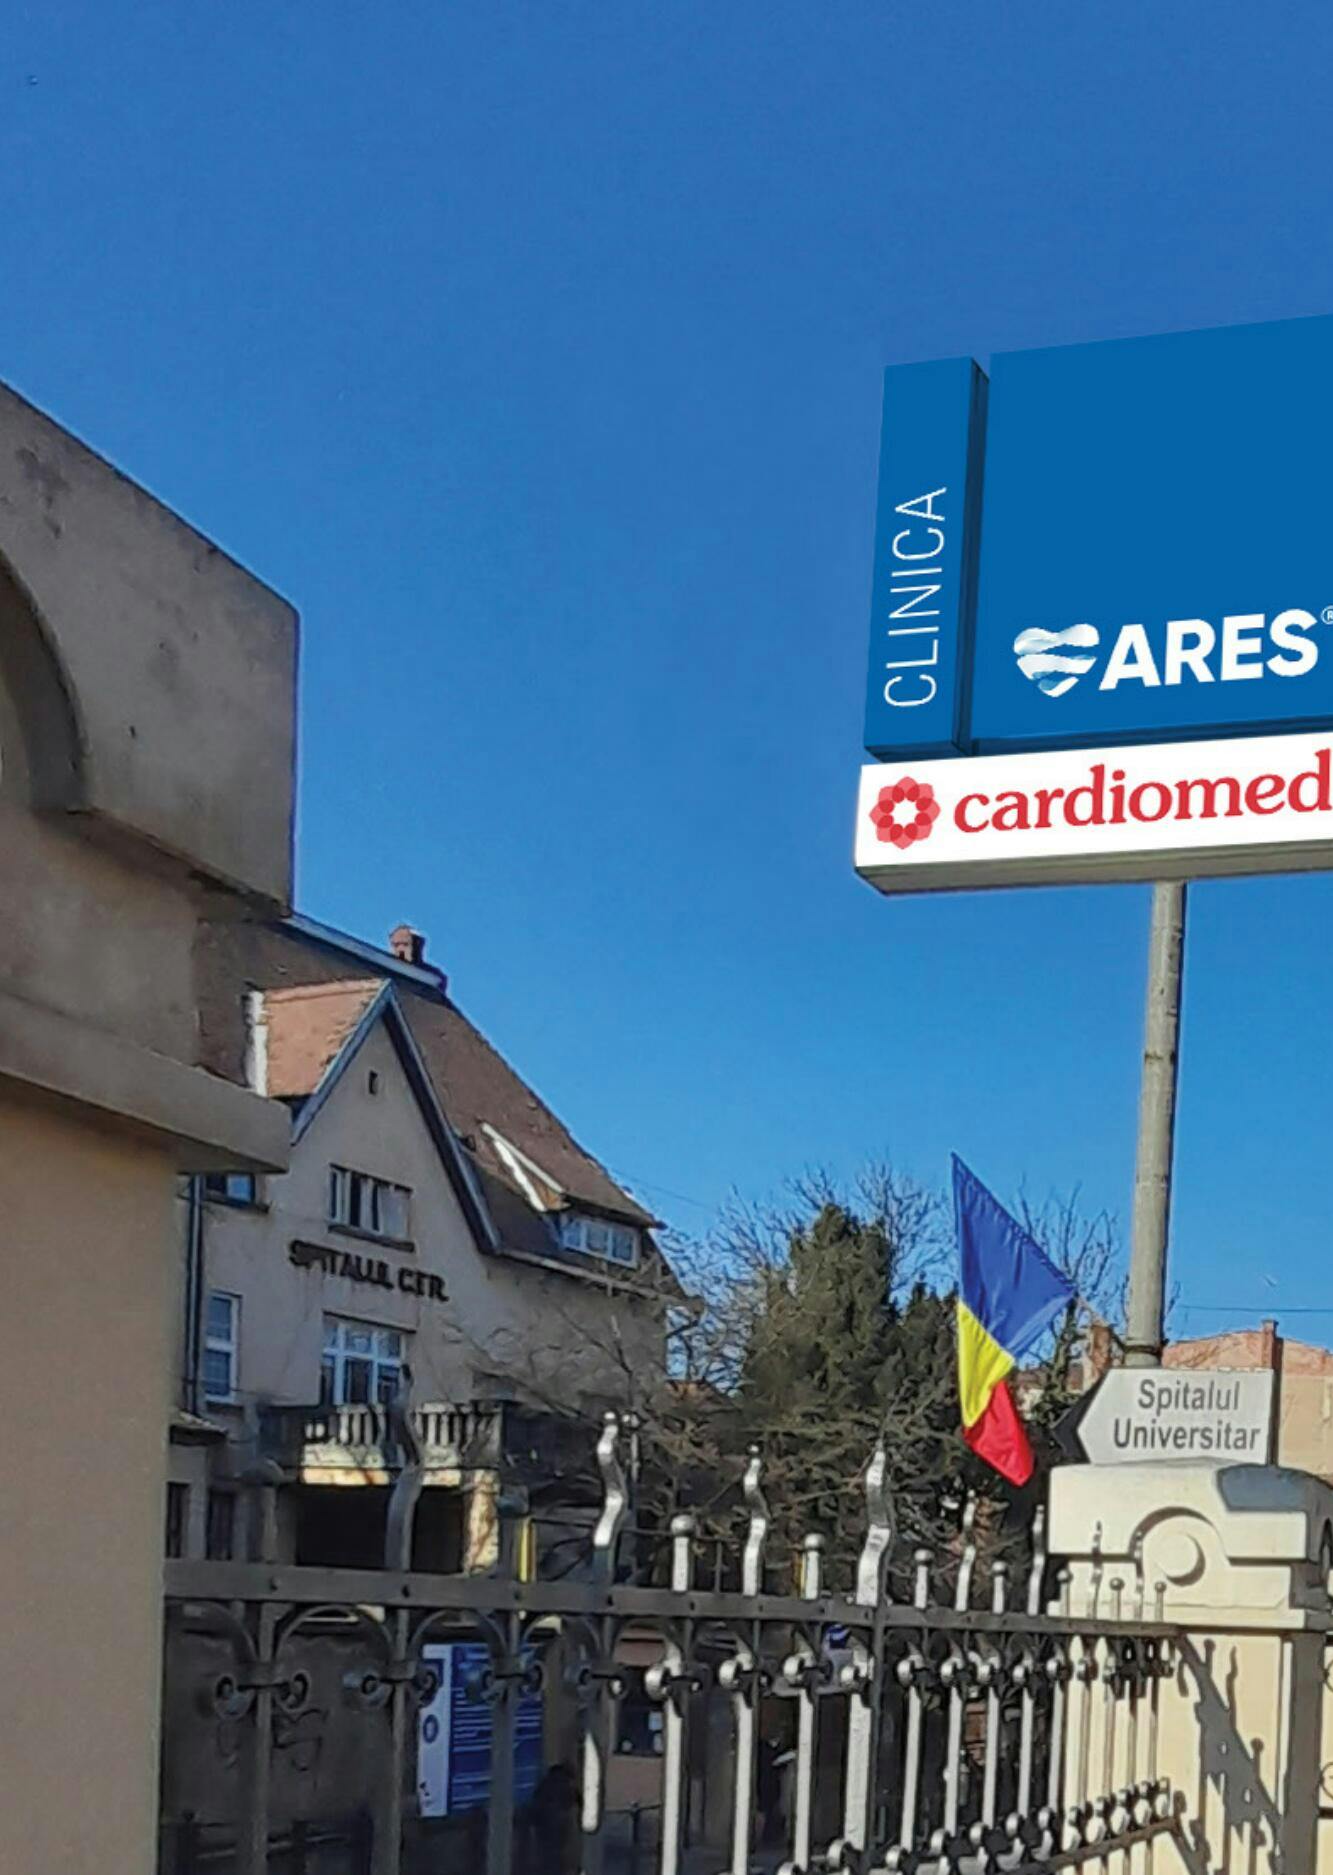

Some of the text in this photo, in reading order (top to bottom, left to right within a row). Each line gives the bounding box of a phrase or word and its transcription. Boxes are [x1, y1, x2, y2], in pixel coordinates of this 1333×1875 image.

[884, 487, 948, 707] CLINICA
[1138, 1378, 1240, 1416] Spitalul
[1113, 1418, 1260, 1450] Universitar
